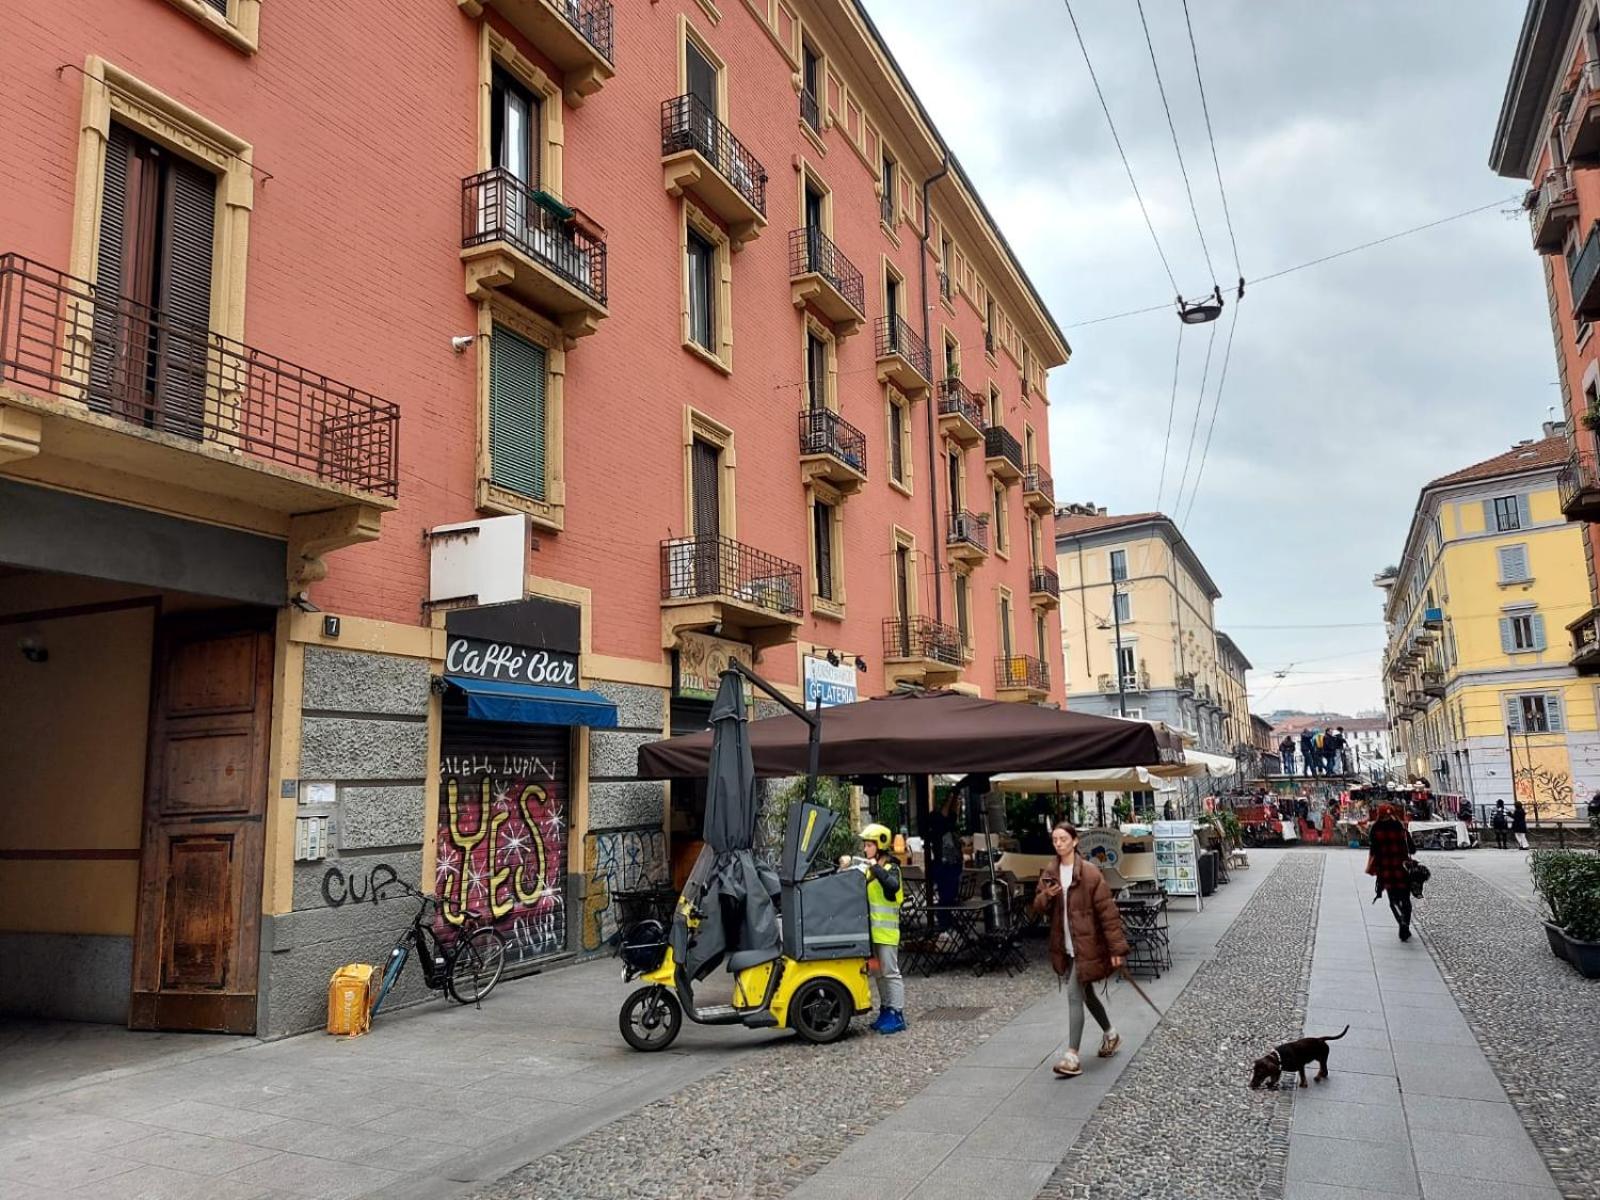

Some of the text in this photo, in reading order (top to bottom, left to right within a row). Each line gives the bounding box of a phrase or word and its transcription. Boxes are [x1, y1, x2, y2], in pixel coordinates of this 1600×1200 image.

[446, 639, 576, 684] Caffè Bar
[810, 682, 854, 703] GELATERIA
